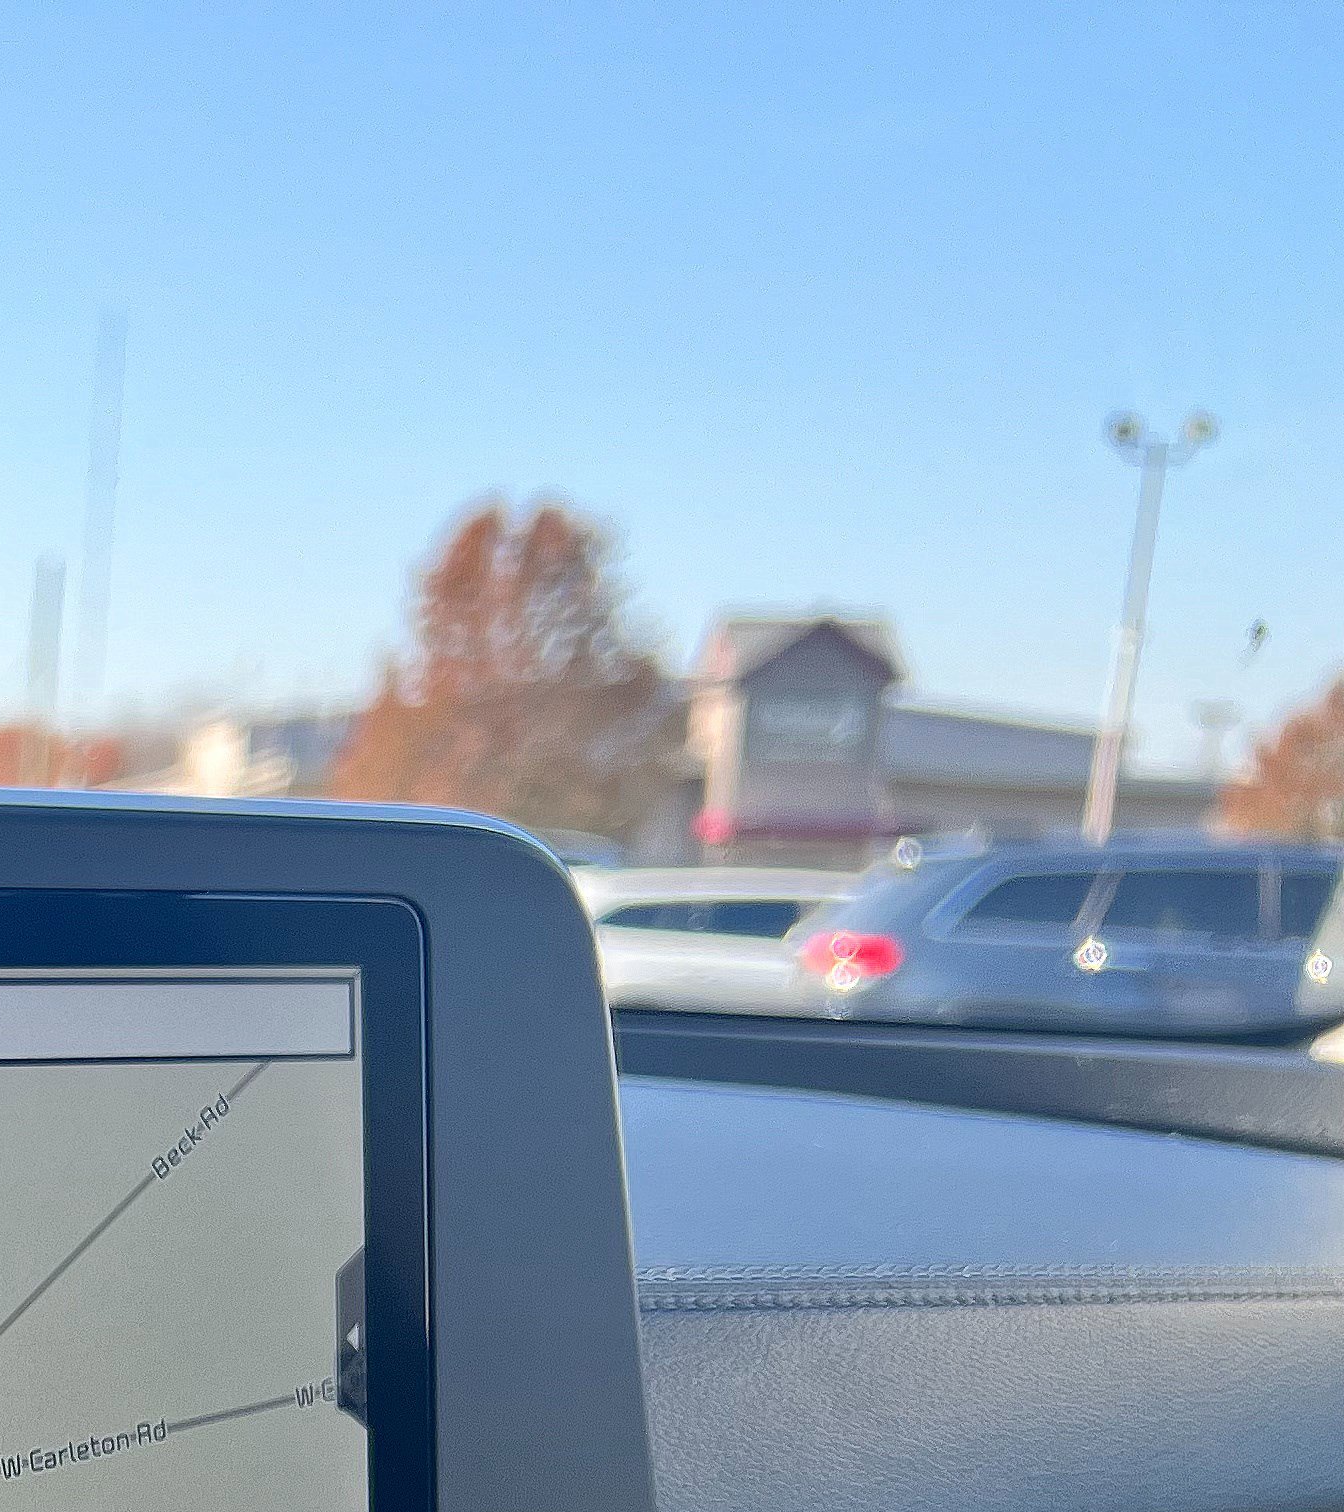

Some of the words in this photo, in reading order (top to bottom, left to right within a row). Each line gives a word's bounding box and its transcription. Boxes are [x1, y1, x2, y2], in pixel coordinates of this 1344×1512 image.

[152, 1127, 202, 1180] Beck
[200, 1092, 229, 1130] Rd
[1, 1453, 21, 1480] W
[29, 1431, 130, 1472] Carleton
[136, 1418, 167, 1447] Rd
